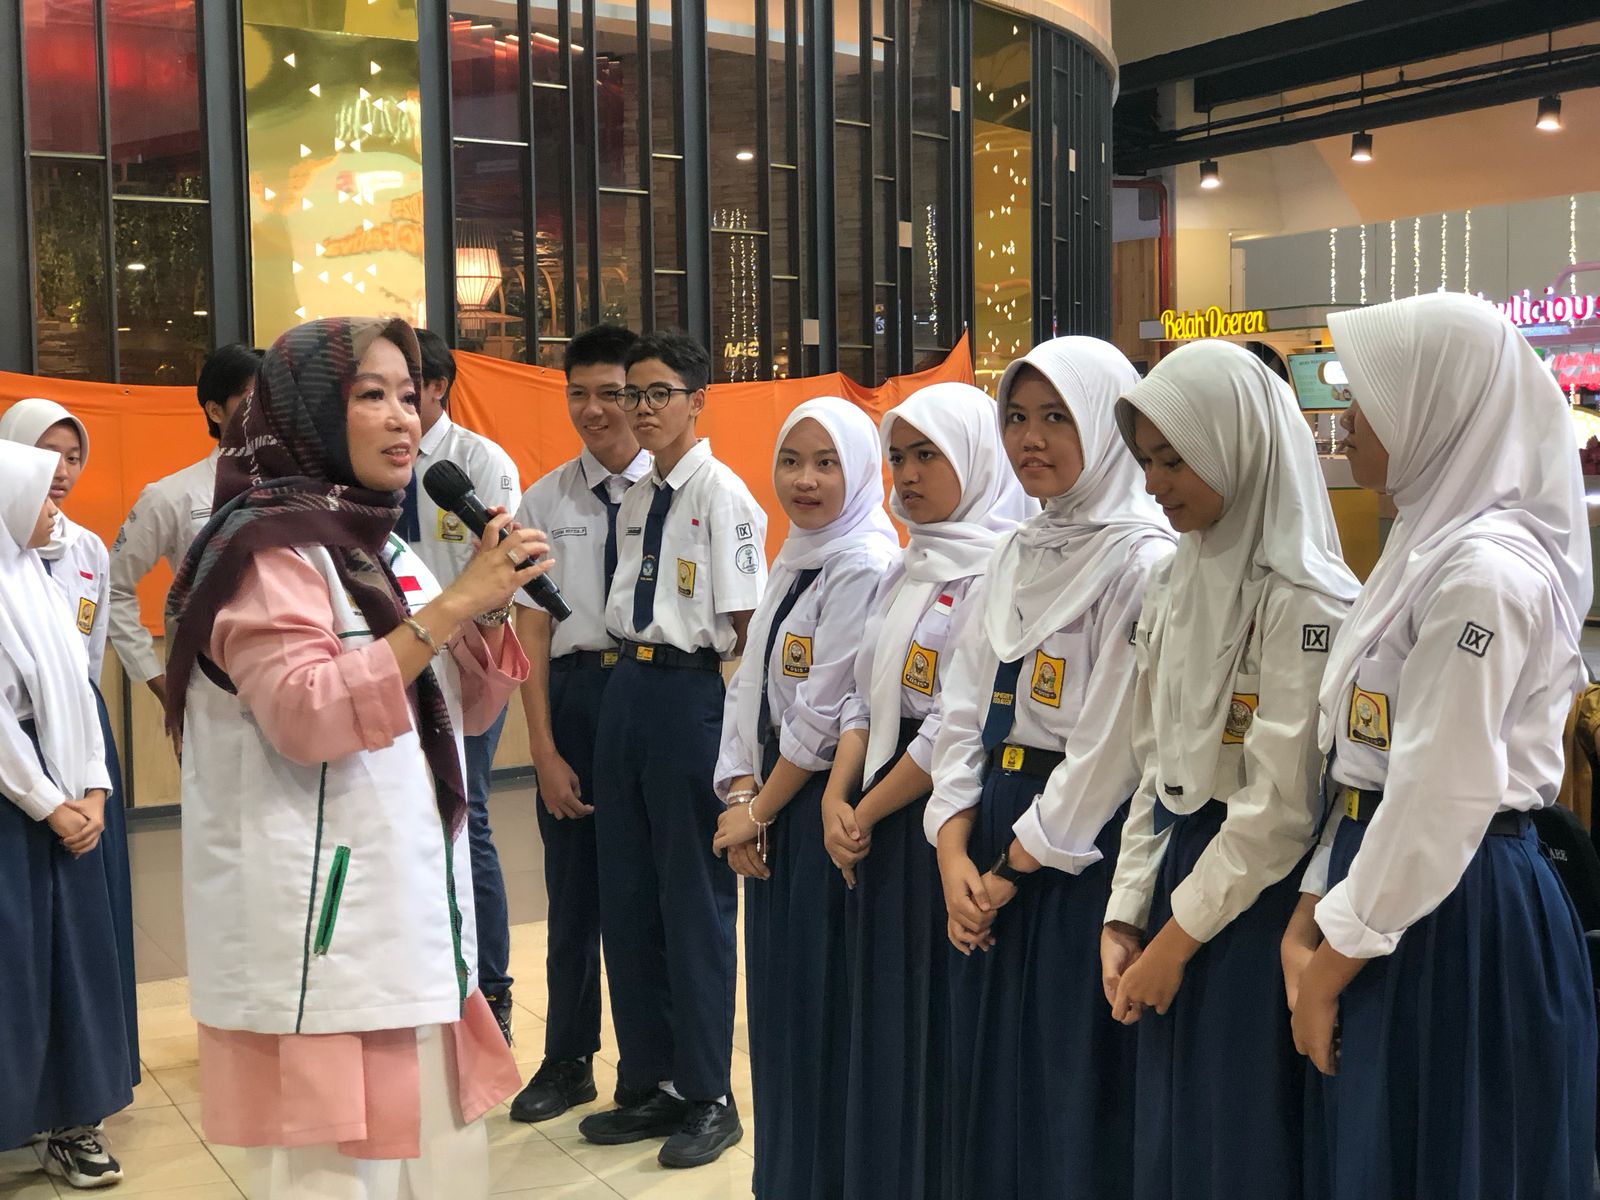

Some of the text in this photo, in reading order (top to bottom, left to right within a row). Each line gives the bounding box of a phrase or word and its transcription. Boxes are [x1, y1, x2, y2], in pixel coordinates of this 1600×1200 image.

[1161, 305, 1264, 340] Belah Doeren
[1306, 629, 1325, 646] IX
[1465, 628, 1487, 650] IX
